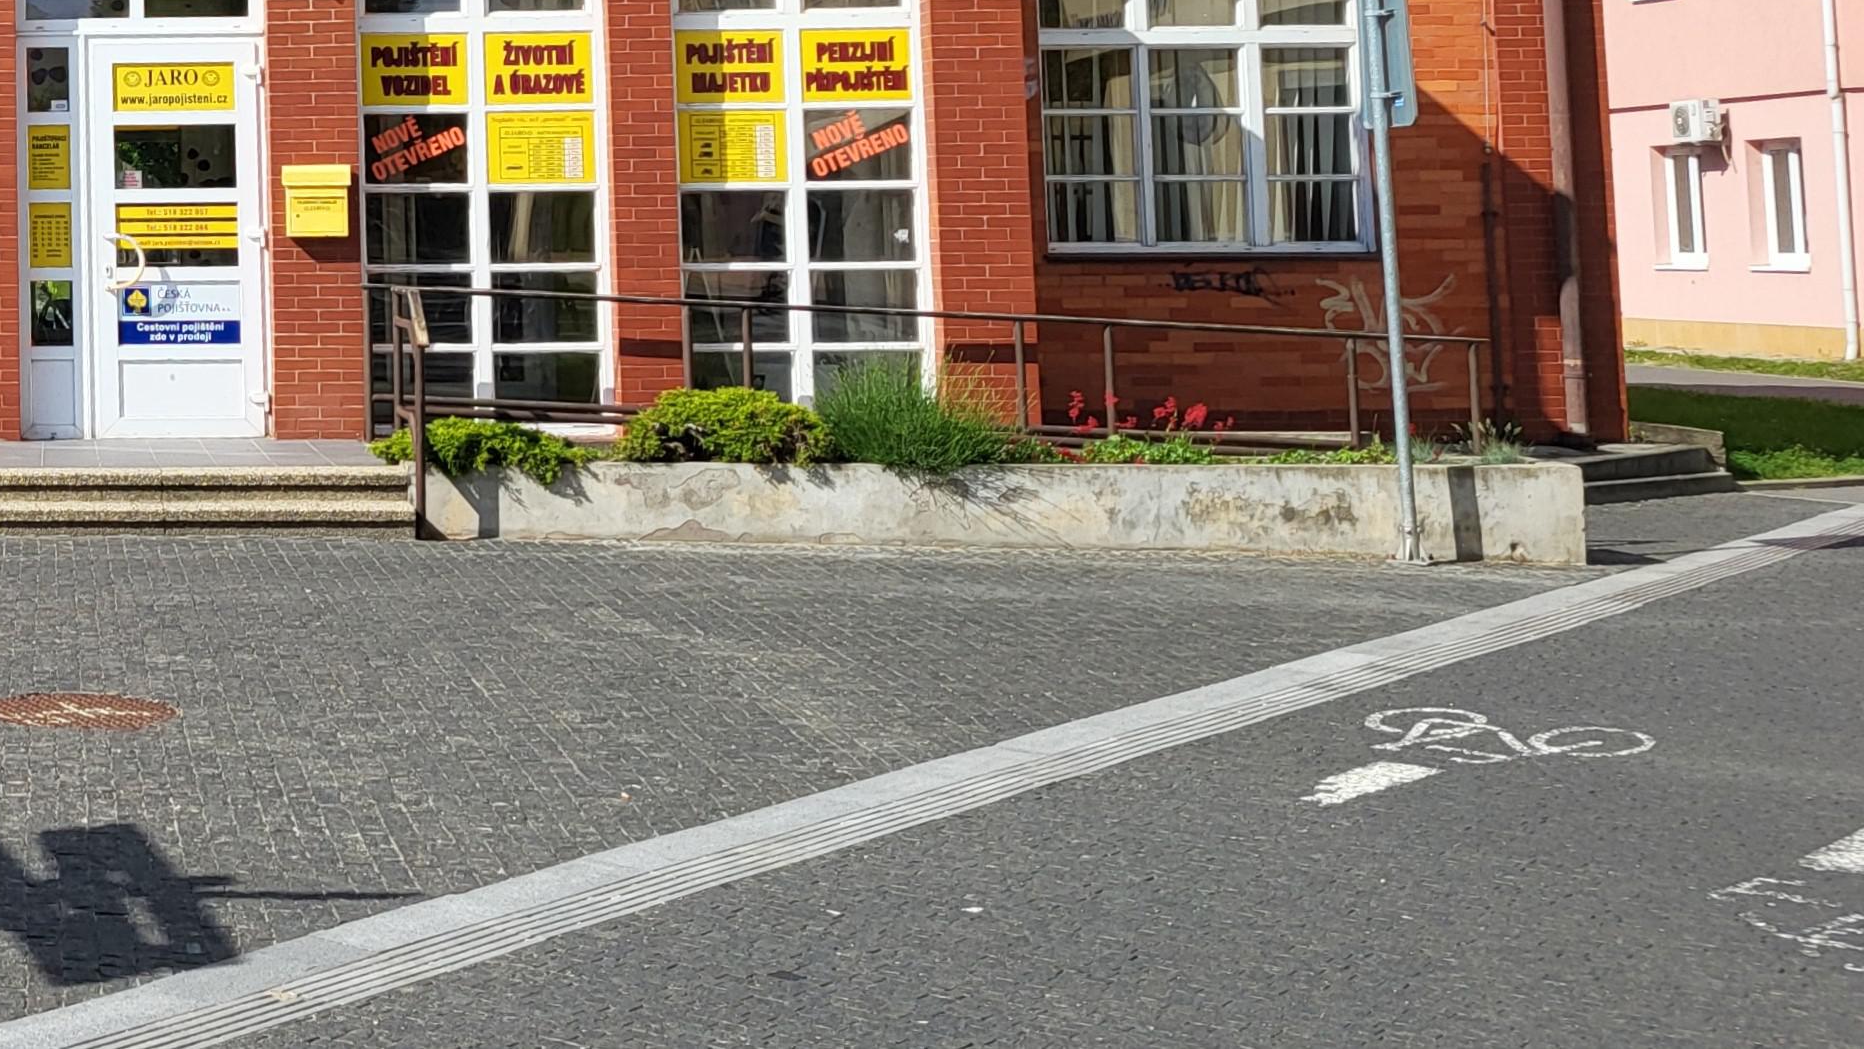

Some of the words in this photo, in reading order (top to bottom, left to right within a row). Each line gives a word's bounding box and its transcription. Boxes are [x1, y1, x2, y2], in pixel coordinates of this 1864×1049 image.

[371, 41, 459, 68] POJIŠTĚNÍ
[503, 40, 575, 66] ŽIVOTNÍ
[686, 38, 776, 64] POJIŠTĚNÍ
[816, 36, 896, 63] PENZIJNÍ
[144, 69, 199, 87] JARO
[380, 75, 452, 96] VOZIDEL
[493, 75, 505, 95] A
[509, 69, 585, 95] ÚRAZOVÉ
[691, 71, 771, 93] MAJETKU
[120, 93, 228, 106] www.jaropojisteni.cz
[371, 116, 423, 154] NOVĚ
[812, 109, 866, 150] NOVĚ
[371, 126, 465, 181] OTEVŘENO
[812, 123, 909, 178] OTEVŘENO
[157, 288, 191, 299] ČESKÁ
[157, 301, 220, 314] POJIŠŤOVNA
[136, 322, 180, 332] Cestovní
[181, 322, 225, 332] pojištění
[149, 332, 167, 341] zde
[177, 332, 212, 342] prodeji
